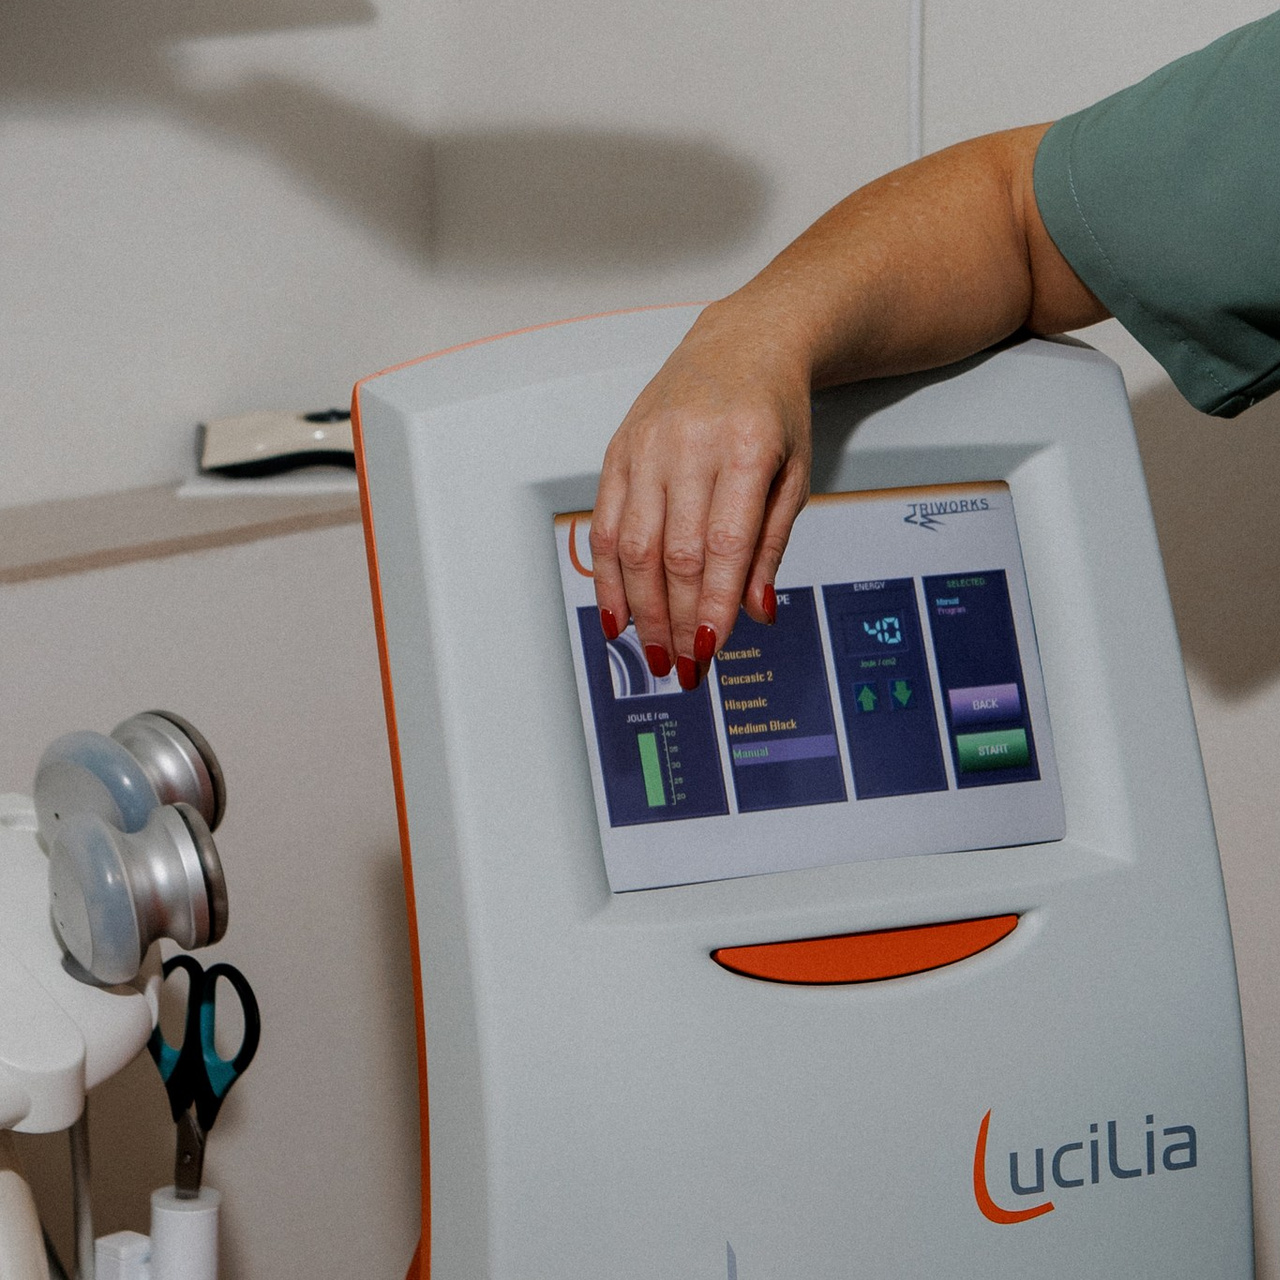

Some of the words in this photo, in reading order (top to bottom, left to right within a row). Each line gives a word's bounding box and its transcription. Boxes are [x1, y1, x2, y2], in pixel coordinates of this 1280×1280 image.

[906, 498, 990, 519] TRIWORKS
[853, 581, 886, 592] ENERGY
[776, 593, 791, 606] PE
[863, 617, 902, 645] 40
[717, 646, 762, 662] Caucasic
[721, 671, 766, 687] Caucasic
[767, 670, 774, 683] 2
[725, 697, 768, 711] Hispanic
[972, 698, 999, 711] BACK
[626, 712, 653, 724] JOULE
[658, 712, 669, 720] cm
[728, 721, 769, 736] Medium
[769, 718, 798, 733] Black
[732, 745, 769, 761] Manual
[979, 745, 1008, 756] START
